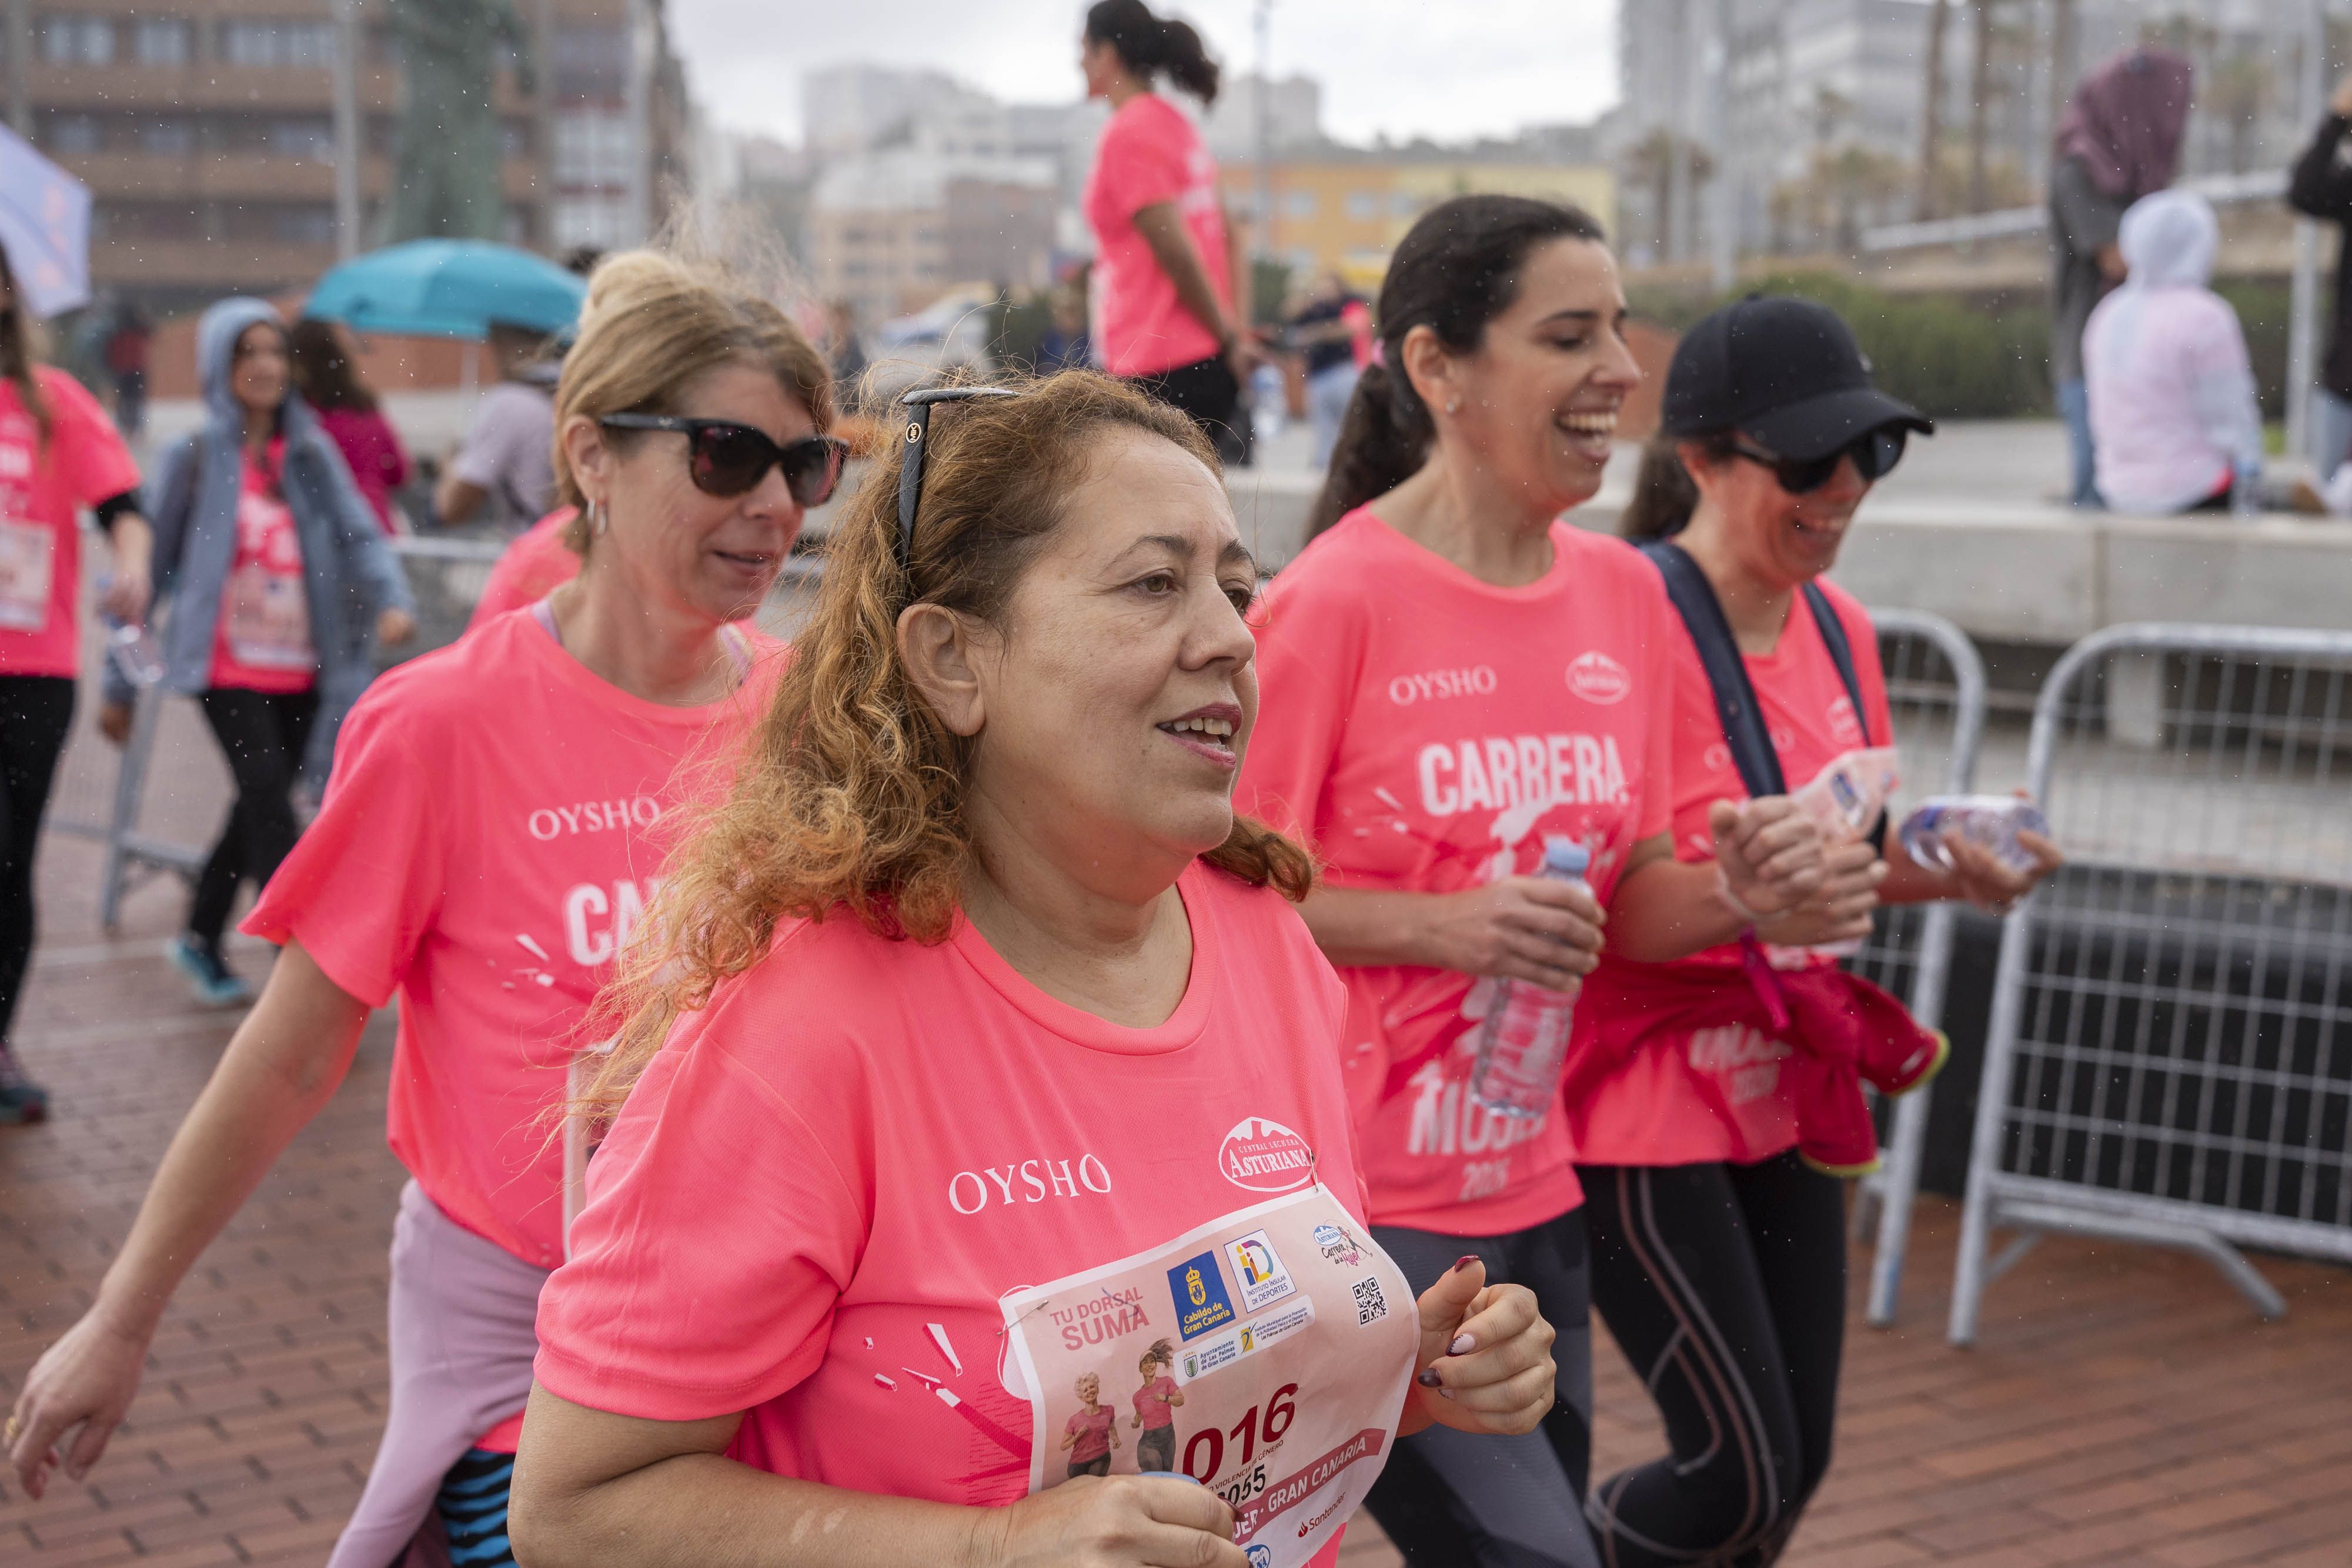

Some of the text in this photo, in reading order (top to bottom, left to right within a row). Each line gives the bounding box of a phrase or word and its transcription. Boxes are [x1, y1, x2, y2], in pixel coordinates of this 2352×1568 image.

[1388, 664, 1498, 706] OYSHO
[530, 796, 661, 841] OYSHO
[1238, 1139, 1299, 1154] CENTRAL LECHERA
[1229, 1148, 1312, 1179] ASTURIANA
[948, 1153, 1111, 1215] OYSHO
[1321, 1243, 1347, 1259] Carrera
[1246, 1275, 1287, 1297] INSTITUTO INSULAR
[1258, 1283, 1288, 1302] DEPORTES
[1050, 1286, 1144, 1326] TU DORSAL
[1184, 1302, 1223, 1325] Cabildo de
[1061, 1303, 1150, 1351] SUMA
[1183, 1309, 1231, 1335] Gran Canaria
[1266, 1330, 1278, 1338] Palmas
[1291, 1319, 1304, 1327] Canaria
[1200, 1340, 1234, 1359] Ayuntamiento
[1218, 1346, 1235, 1357] Palmas
[1219, 1352, 1236, 1362] Canaria
[1182, 1382, 1299, 1486] 016
[1215, 1465, 1251, 1490] VIOLENCIA
[1258, 1439, 1284, 1461] GÉNERO
[1268, 1475, 1308, 1513] GRAN
[1311, 1437, 1366, 1486] CANARIA
[1217, 1463, 1266, 1505] 055
[1309, 1492, 1346, 1531] Santander
